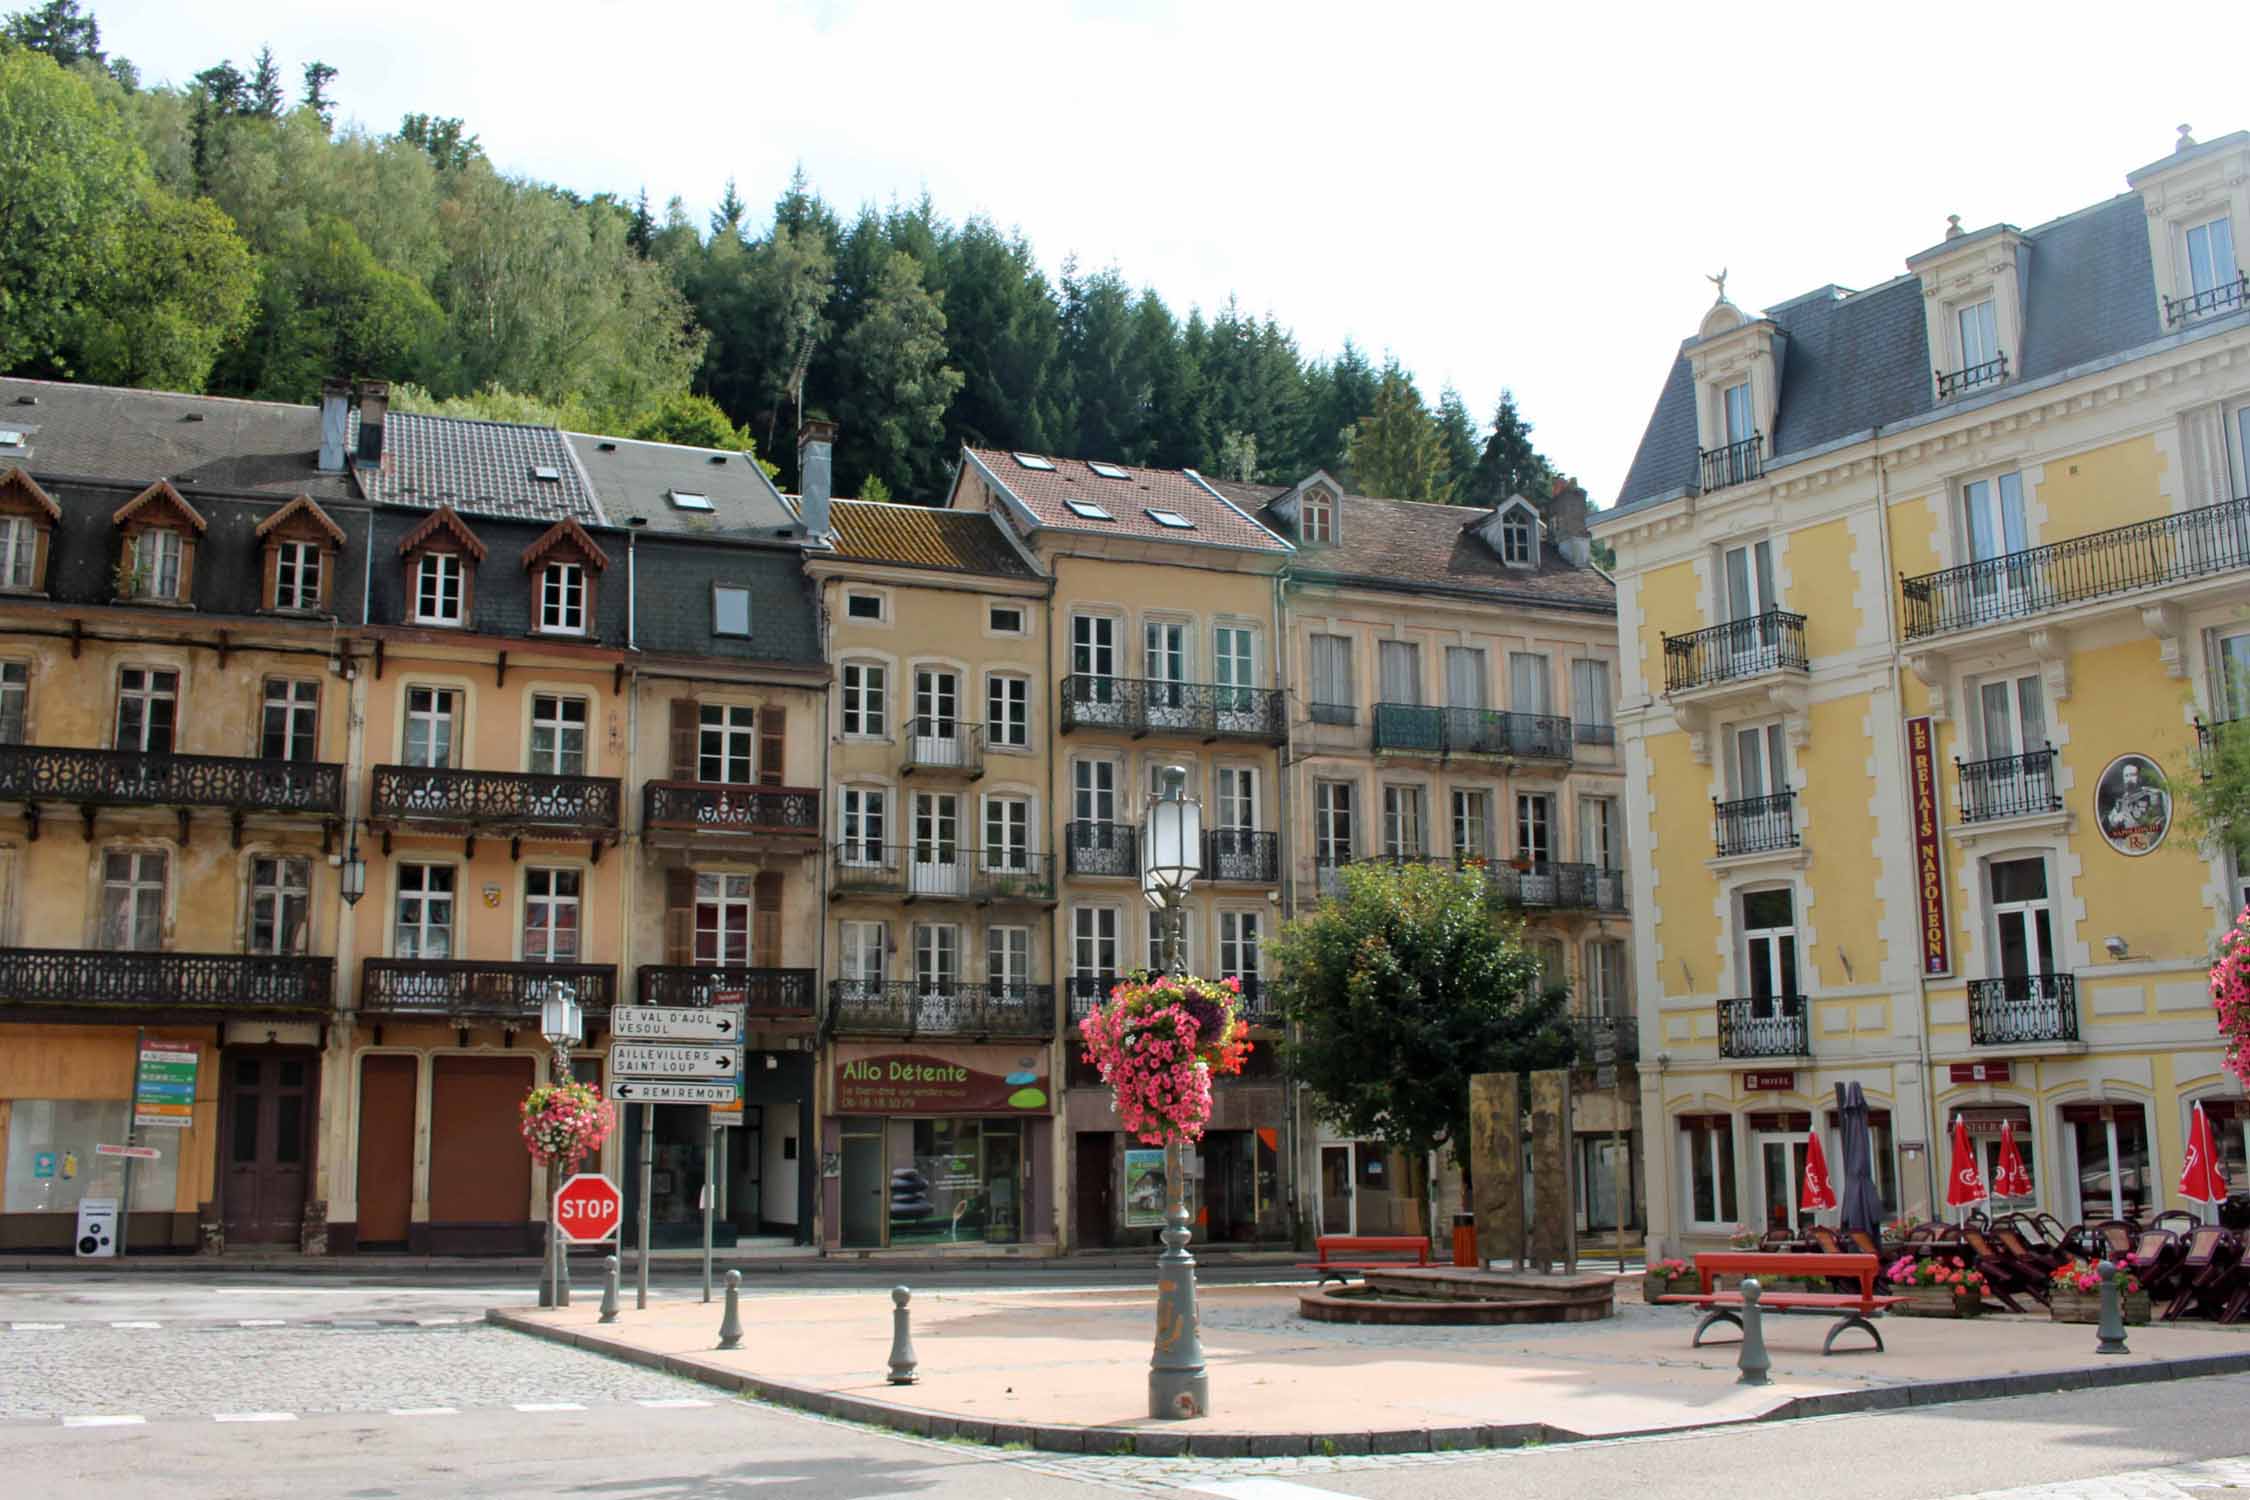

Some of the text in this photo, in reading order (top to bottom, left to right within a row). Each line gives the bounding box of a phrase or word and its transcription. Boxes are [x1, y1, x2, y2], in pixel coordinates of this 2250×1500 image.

[1914, 722, 1942, 956] LE RELAIS NAPOLEON
[618, 1011, 712, 1025] LE VAL D'AJOL
[619, 1023, 669, 1034] VESOUL
[618, 1049, 711, 1061] AILLEVILLERS
[618, 1061, 696, 1072] SAINT LOUP
[843, 1061, 969, 1082] Allo Détente
[642, 1087, 731, 1099] REMIREMONT
[562, 1199, 615, 1219] STOP
